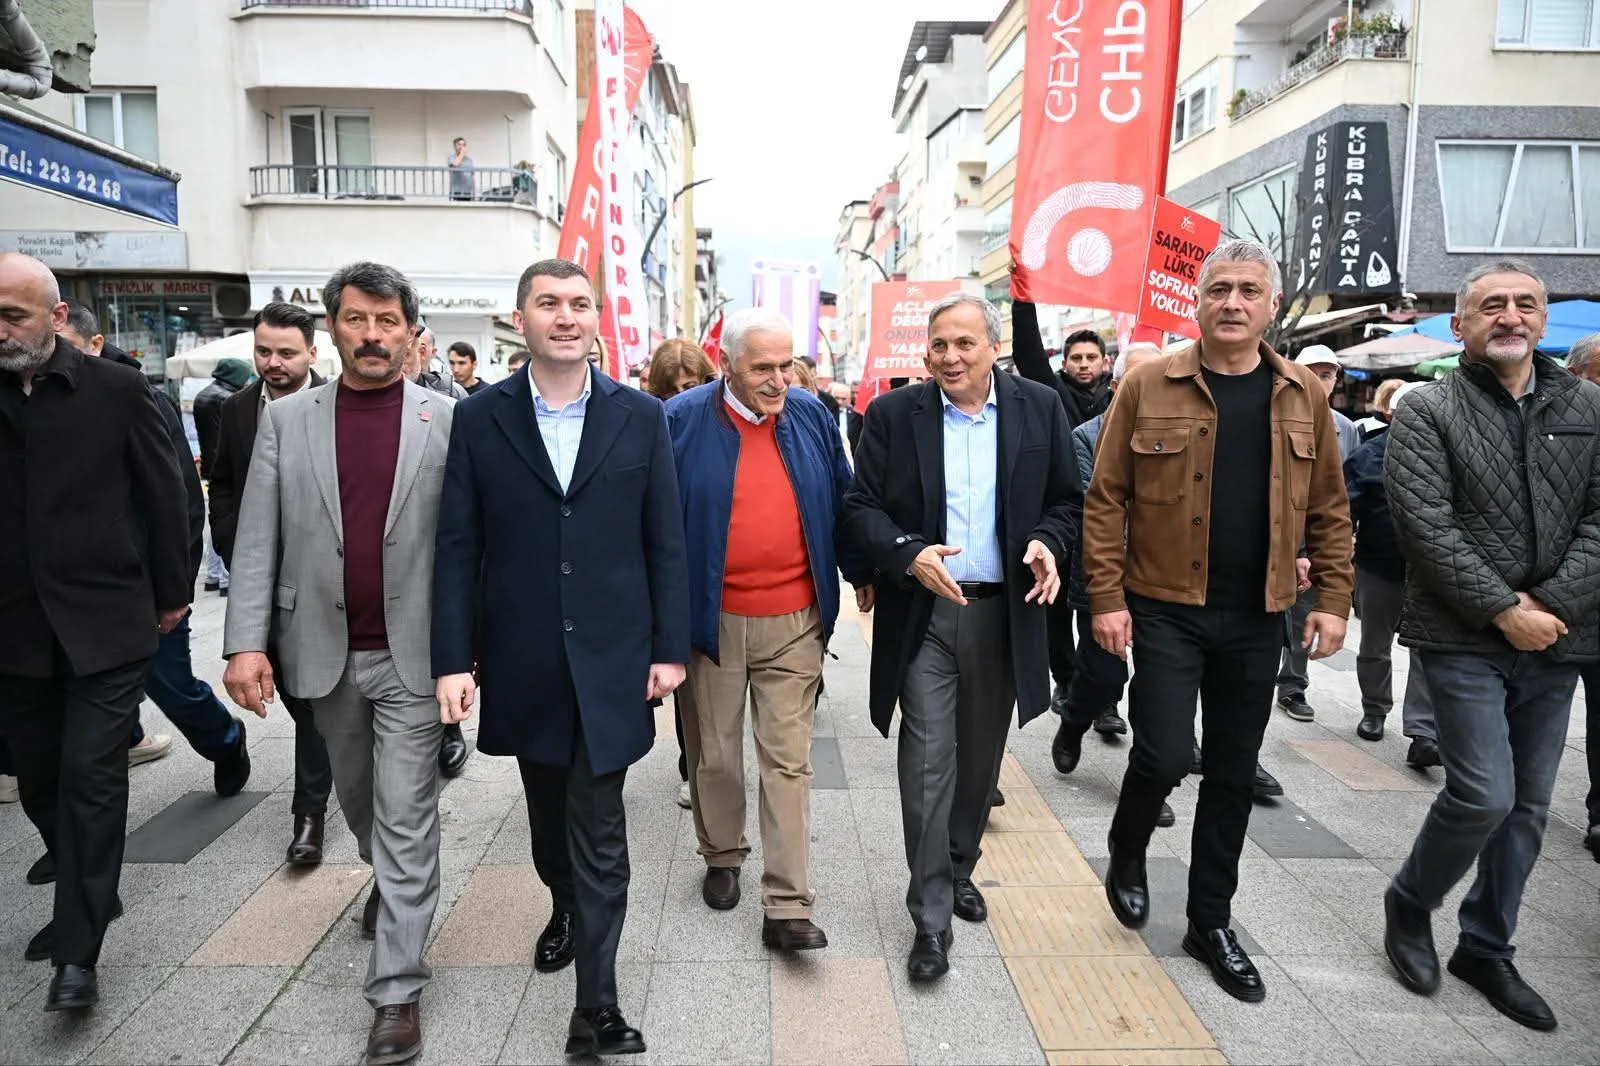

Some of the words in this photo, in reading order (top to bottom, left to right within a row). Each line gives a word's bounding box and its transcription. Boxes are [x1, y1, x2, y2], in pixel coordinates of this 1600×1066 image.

[0, 143, 33, 176] Tel:
[39, 157, 71, 184] 223
[76, 170, 97, 194] 22
[102, 179, 121, 201] 68
[1313, 132, 1328, 205] KÜBRA
[1344, 127, 1367, 201] KÜBRA
[1163, 254, 1196, 282] LÜKS,
[1338, 211, 1361, 287] ÇANTA
[1148, 269, 1200, 302] SOFRAD
